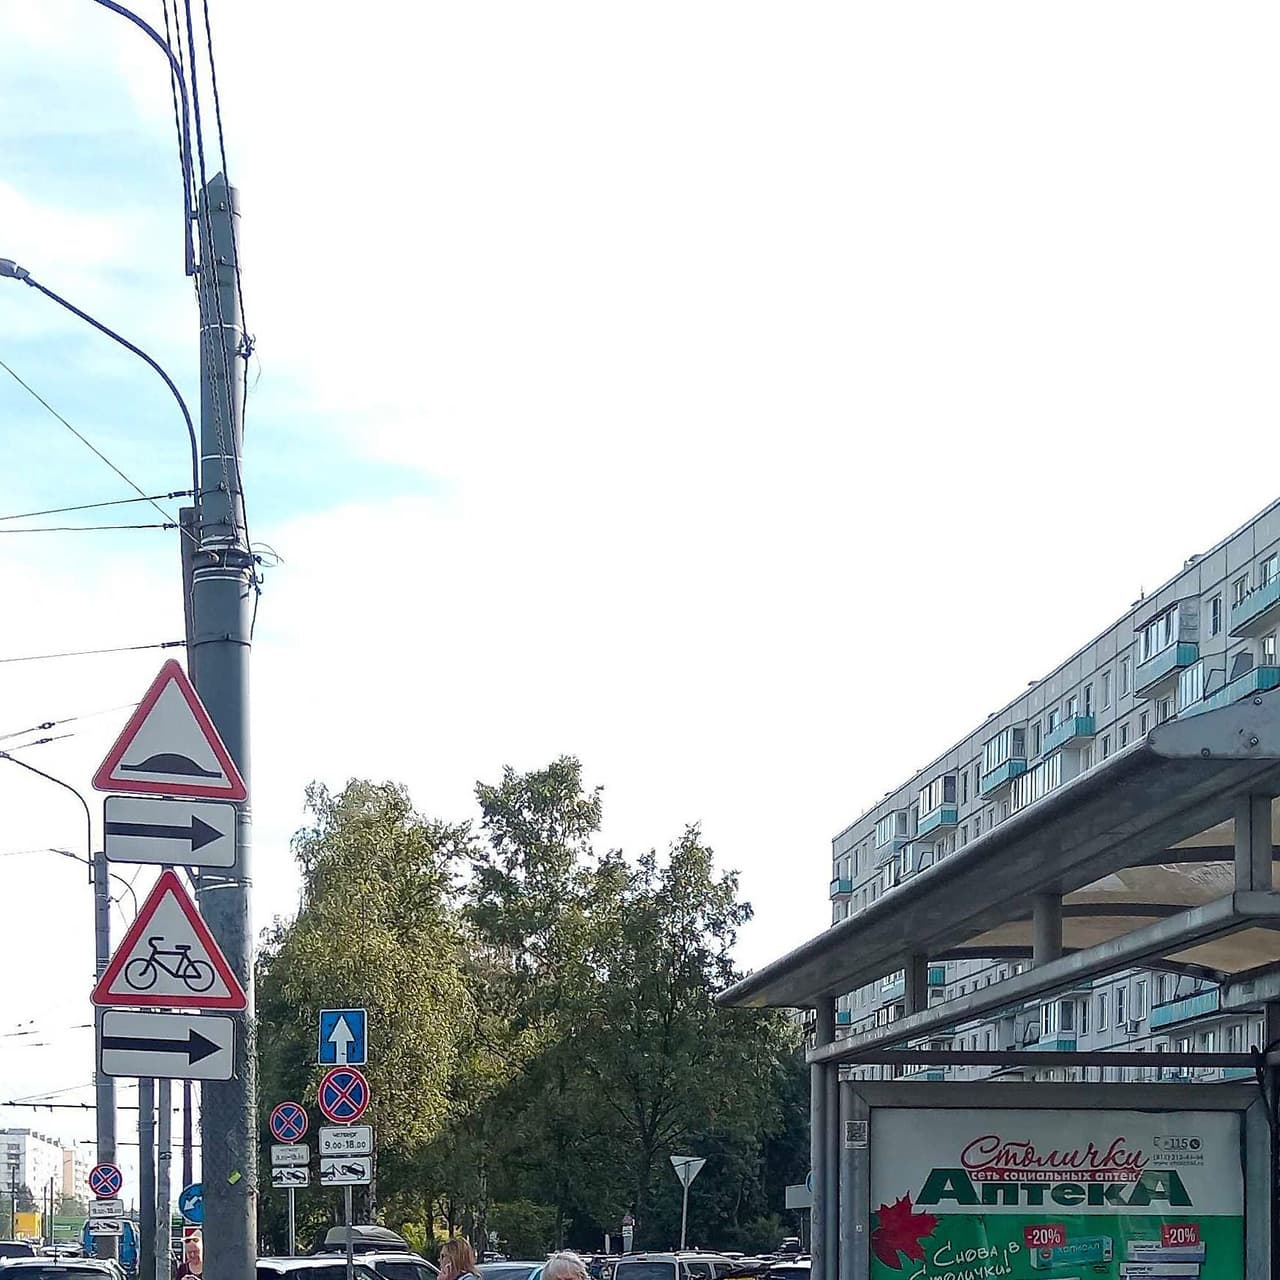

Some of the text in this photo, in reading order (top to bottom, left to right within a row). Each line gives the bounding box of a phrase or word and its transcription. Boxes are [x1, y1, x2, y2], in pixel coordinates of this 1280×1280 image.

[961, 1135, 1150, 1169] Столички
[971, 1171, 1137, 1182] сеть социальных аптек
[1027, 1229, 1061, 1245] -20%
[1164, 1228, 1196, 1244] -20%
